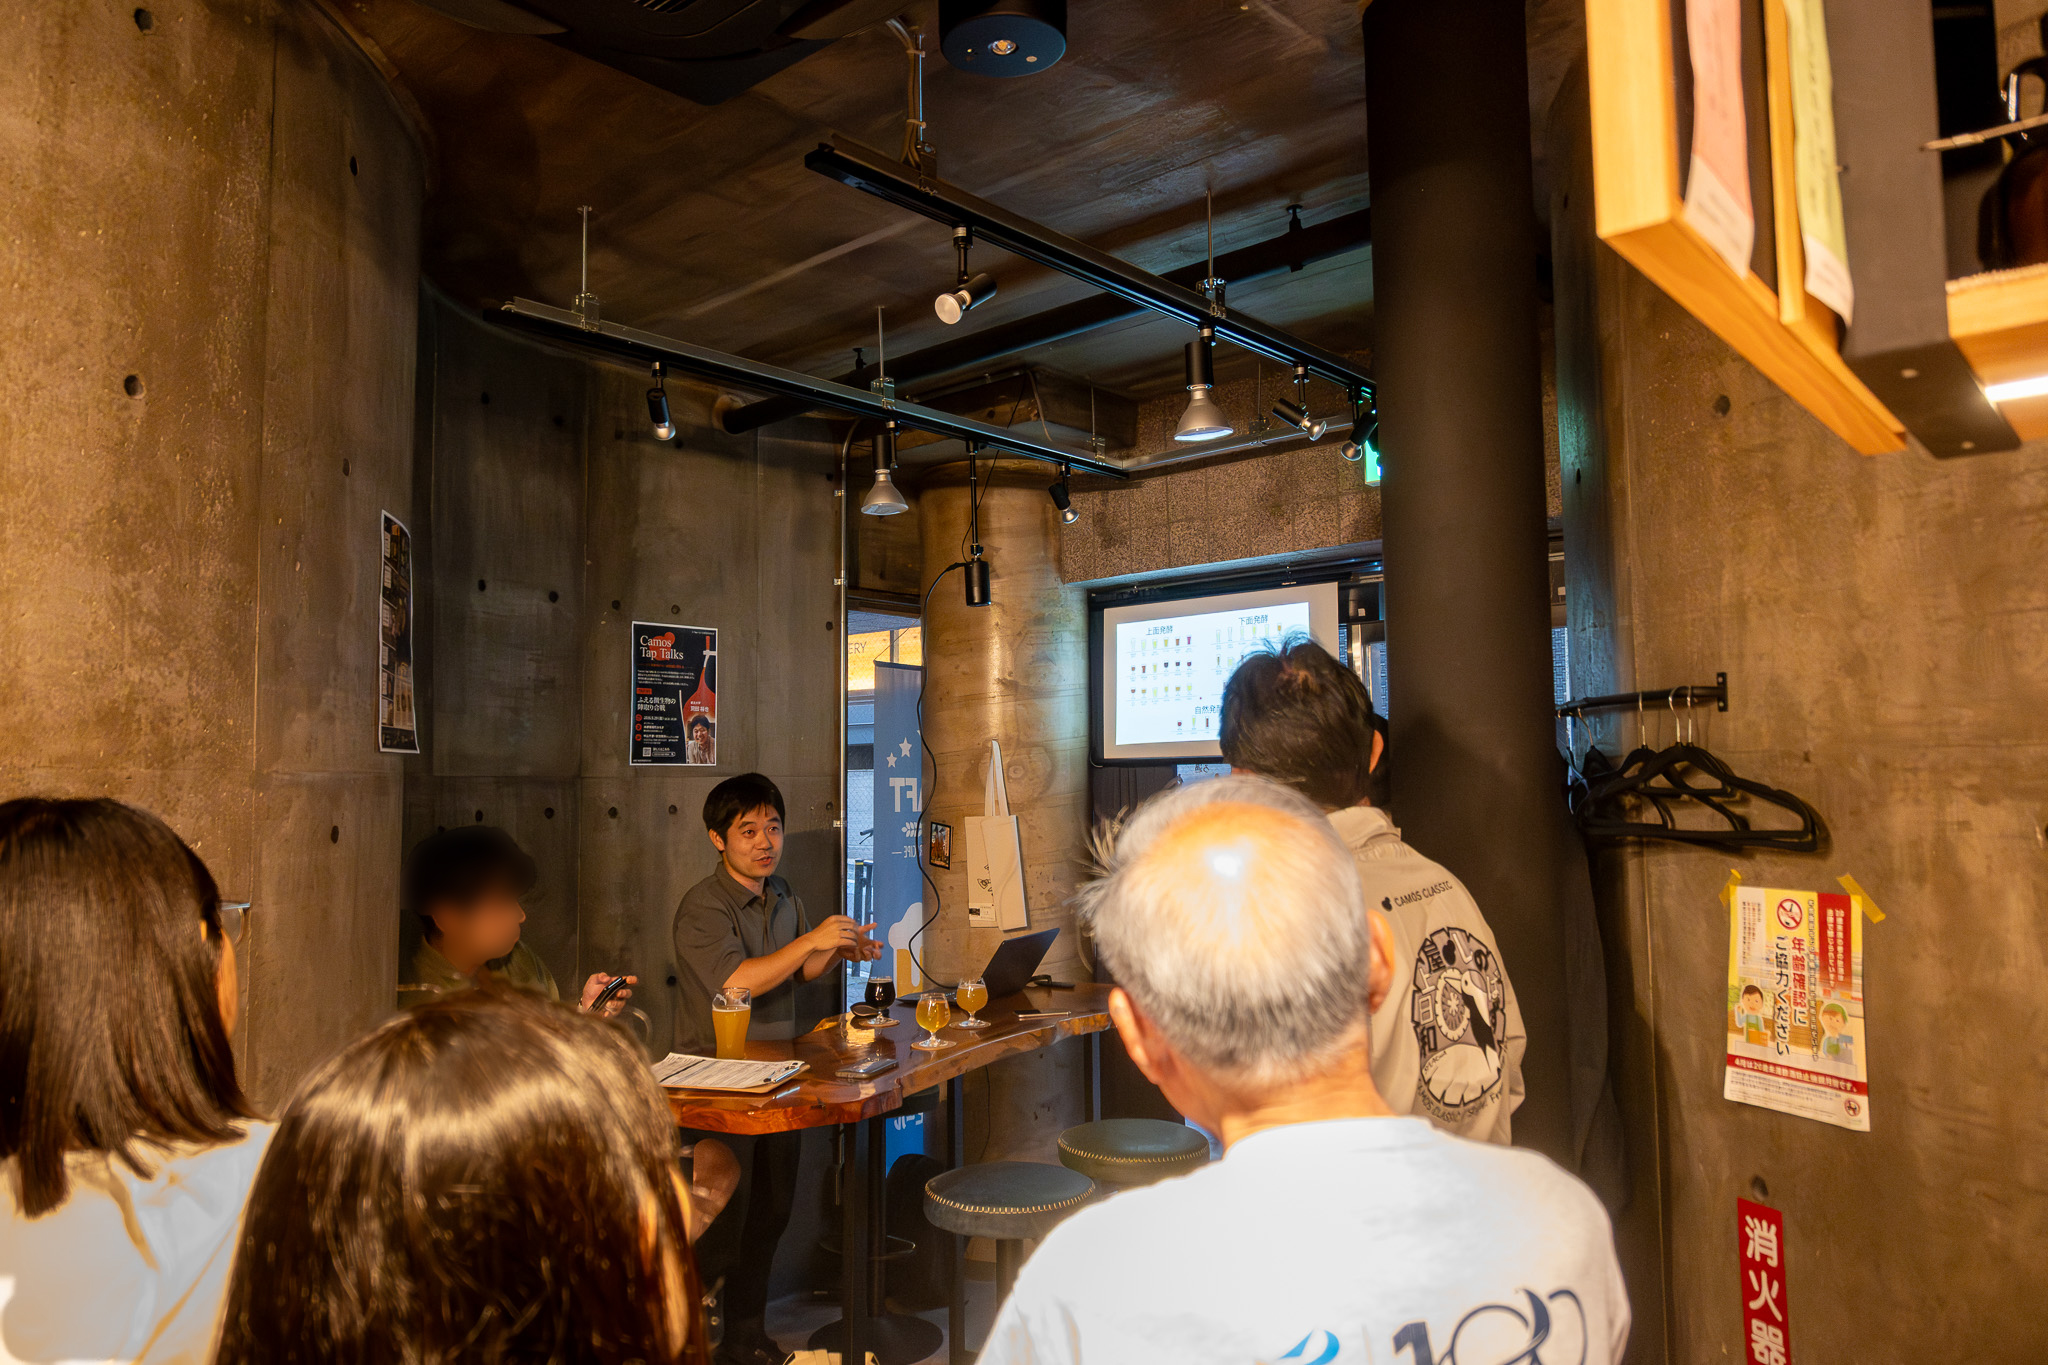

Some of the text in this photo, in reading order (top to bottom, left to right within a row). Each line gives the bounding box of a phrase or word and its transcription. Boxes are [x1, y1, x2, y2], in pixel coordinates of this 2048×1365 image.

[1238, 614, 1268, 626] 下面発酵
[1146, 625, 1173, 636] 上面発酵
[640, 634, 672, 648] Camos
[639, 647, 684, 660] Tap Talks
[1394, 881, 1453, 907] CAMOS CLASSIC
[1792, 936, 1807, 1024] 年齢確認に
[1776, 936, 1790, 1056] ご協力ください
[1745, 1214, 1787, 1365] 消火器
